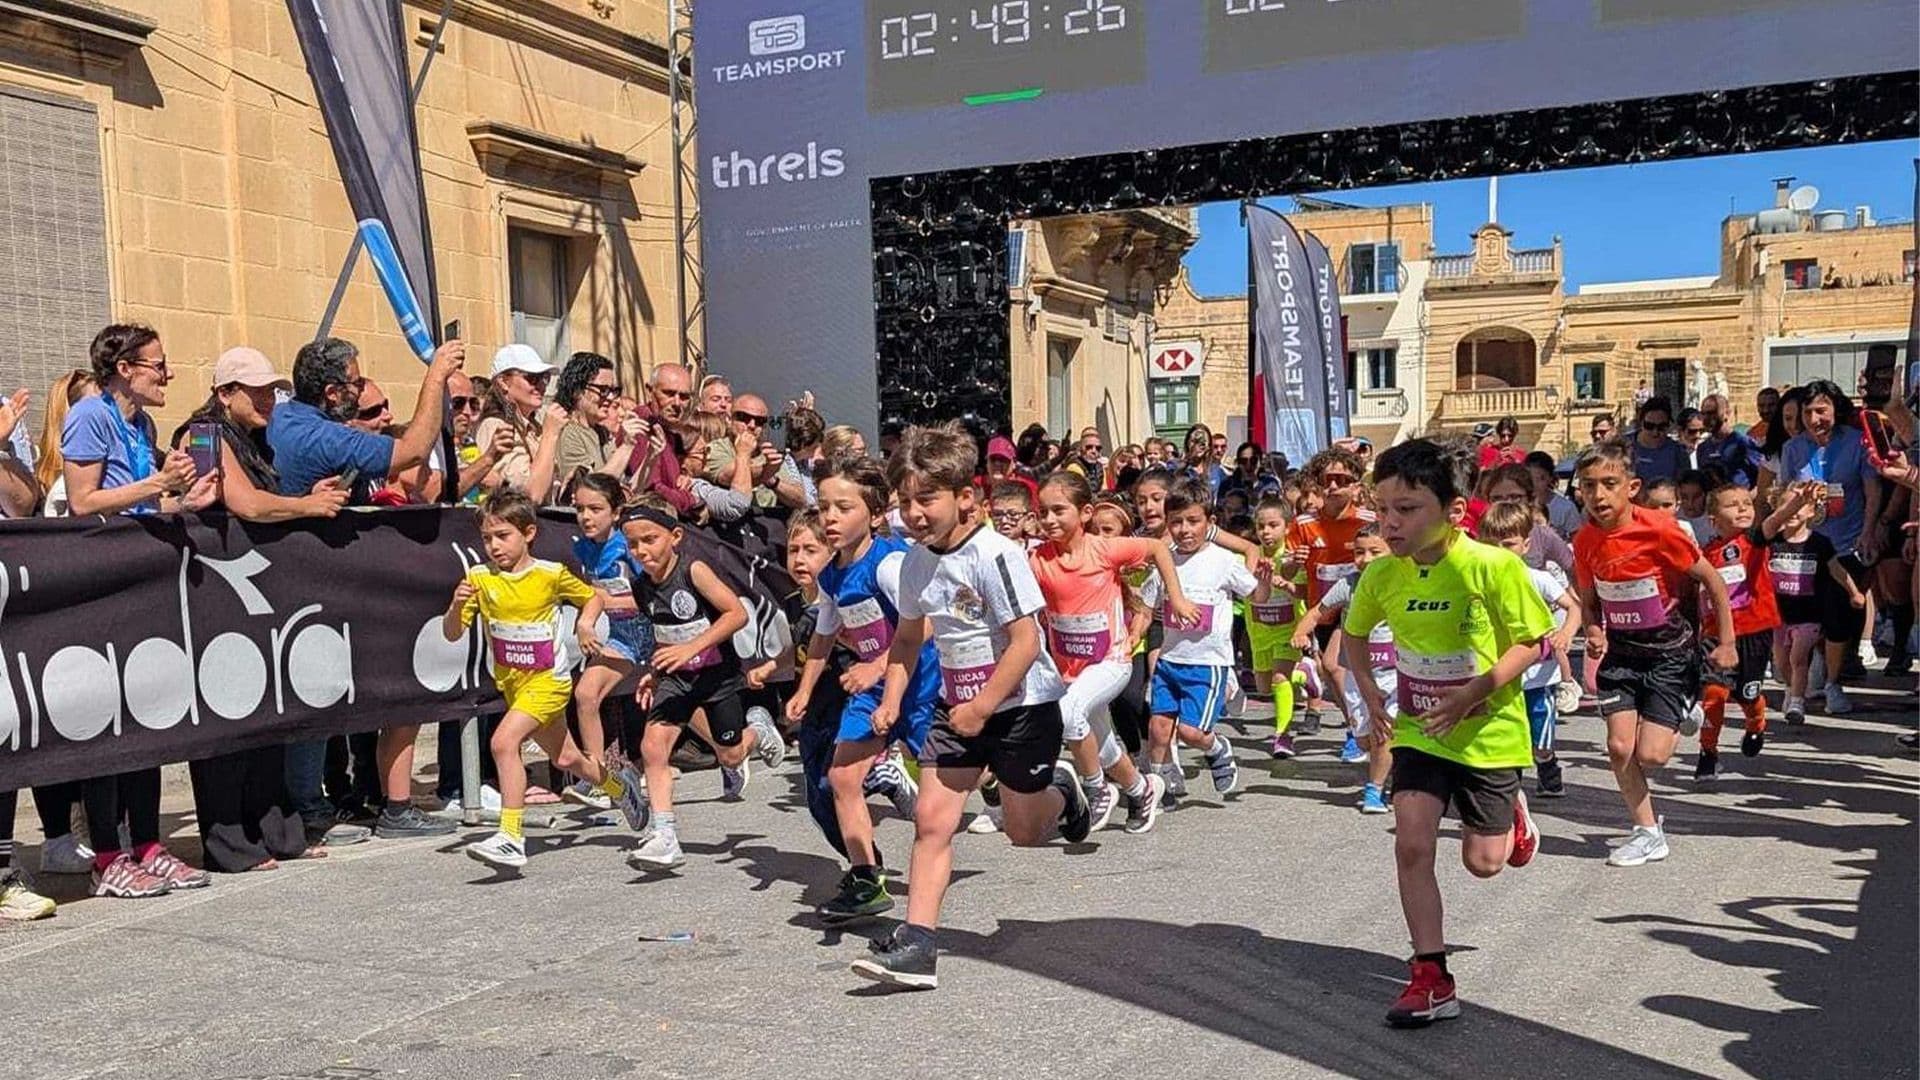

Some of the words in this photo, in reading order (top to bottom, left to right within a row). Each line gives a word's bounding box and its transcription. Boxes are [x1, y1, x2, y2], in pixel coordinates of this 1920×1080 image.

[712, 49, 846, 83] TEAMSPORT
[1406, 599, 1451, 612] Zeus
[1610, 612, 1642, 624] 6073
[1065, 643, 1094, 656] 6052
[505, 651, 536, 665] 6006
[953, 671, 987, 684] LUCAS
